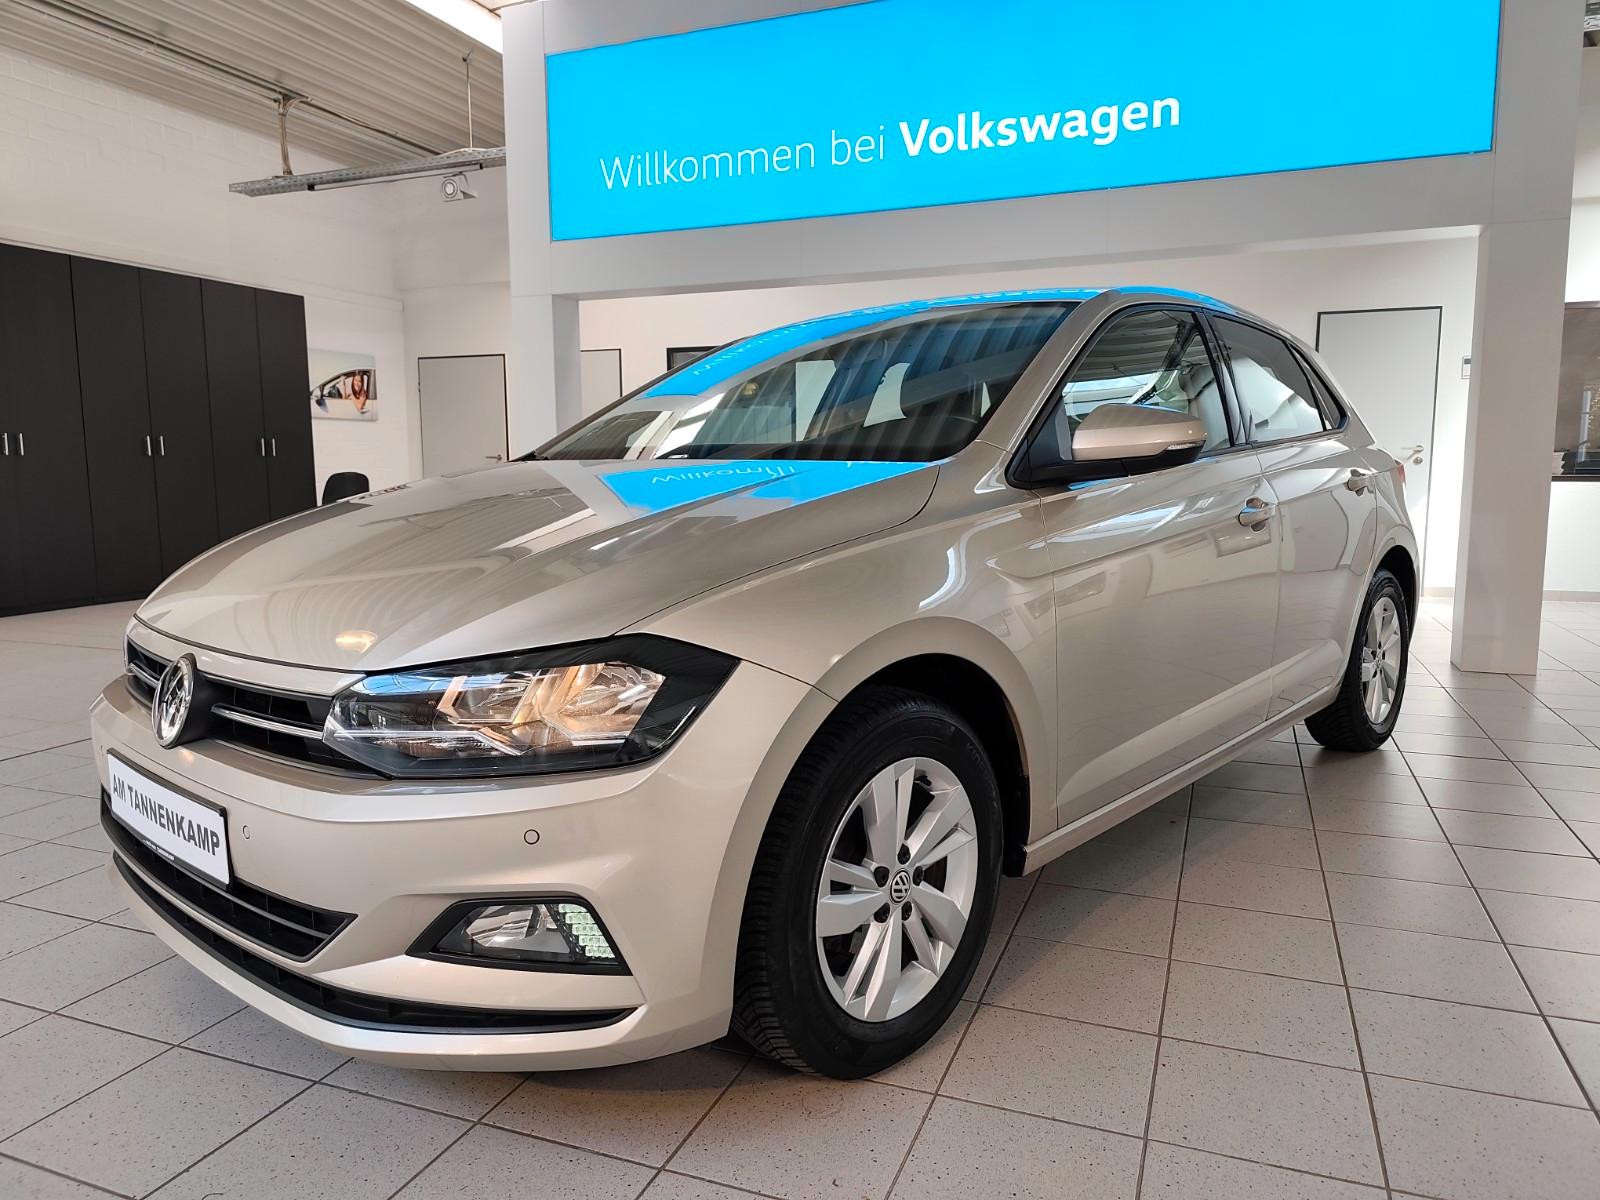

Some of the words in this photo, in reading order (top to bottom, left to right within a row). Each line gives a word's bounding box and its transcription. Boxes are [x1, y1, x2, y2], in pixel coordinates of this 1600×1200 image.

[600, 143, 815, 189] Willkommen
[831, 125, 885, 165] bei
[899, 98, 1180, 156] Volkswagen
[113, 773, 126, 803] AM
[127, 784, 220, 856] TANNENKAMP
